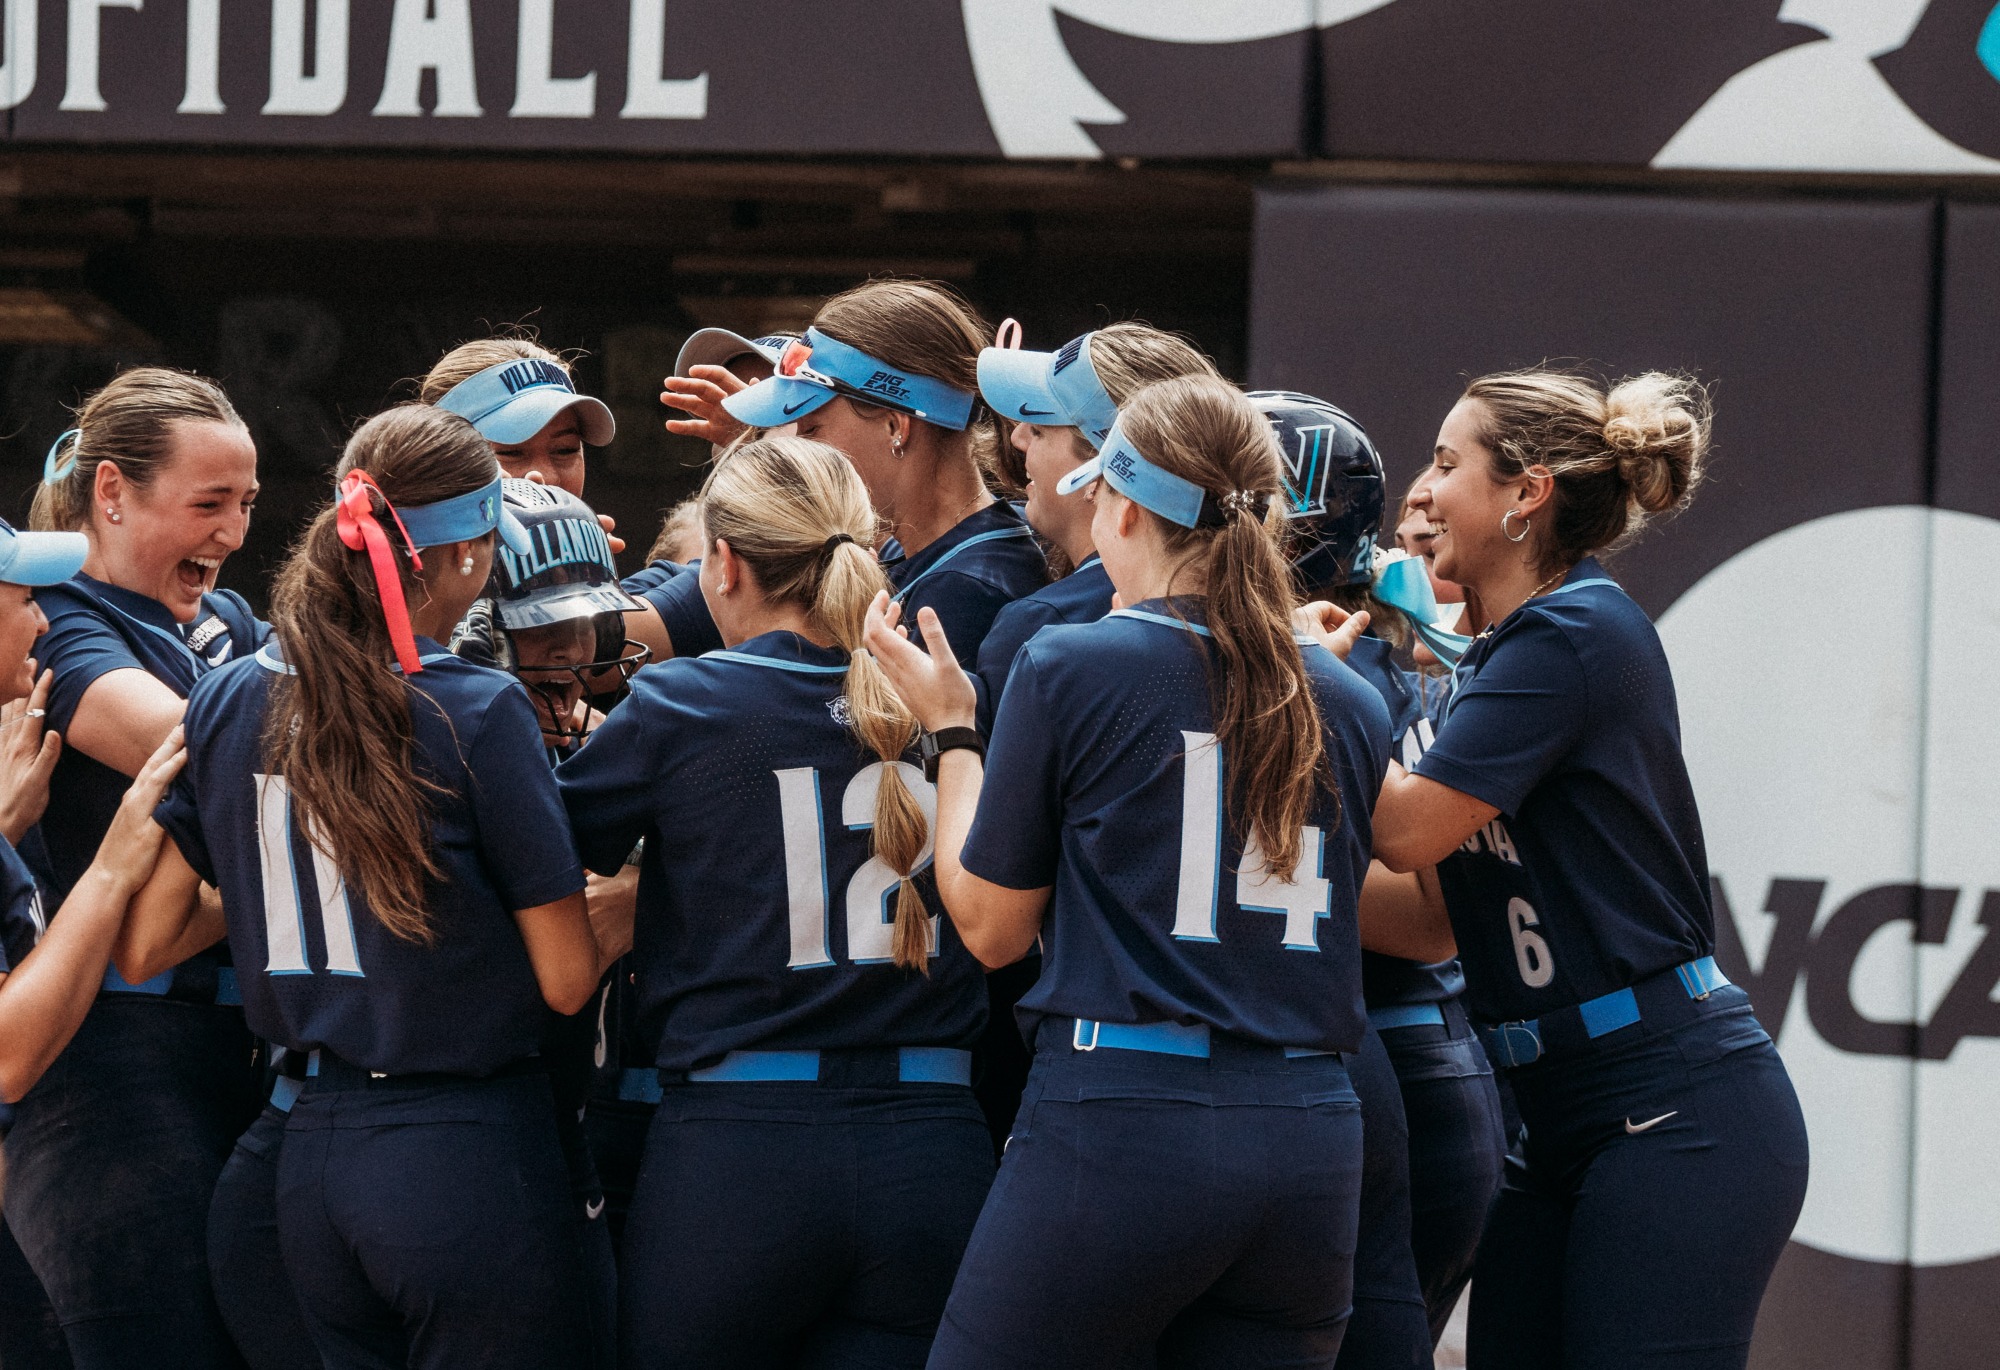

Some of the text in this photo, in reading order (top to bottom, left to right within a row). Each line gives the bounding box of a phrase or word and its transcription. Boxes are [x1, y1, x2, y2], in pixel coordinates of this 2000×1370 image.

[870, 371, 906, 386] BIG
[1114, 450, 1135, 468] BIG
[253, 773, 365, 977] 11
[773, 760, 941, 971] 12
[1170, 730, 1332, 952] 14
[1508, 897, 1554, 988] 6
